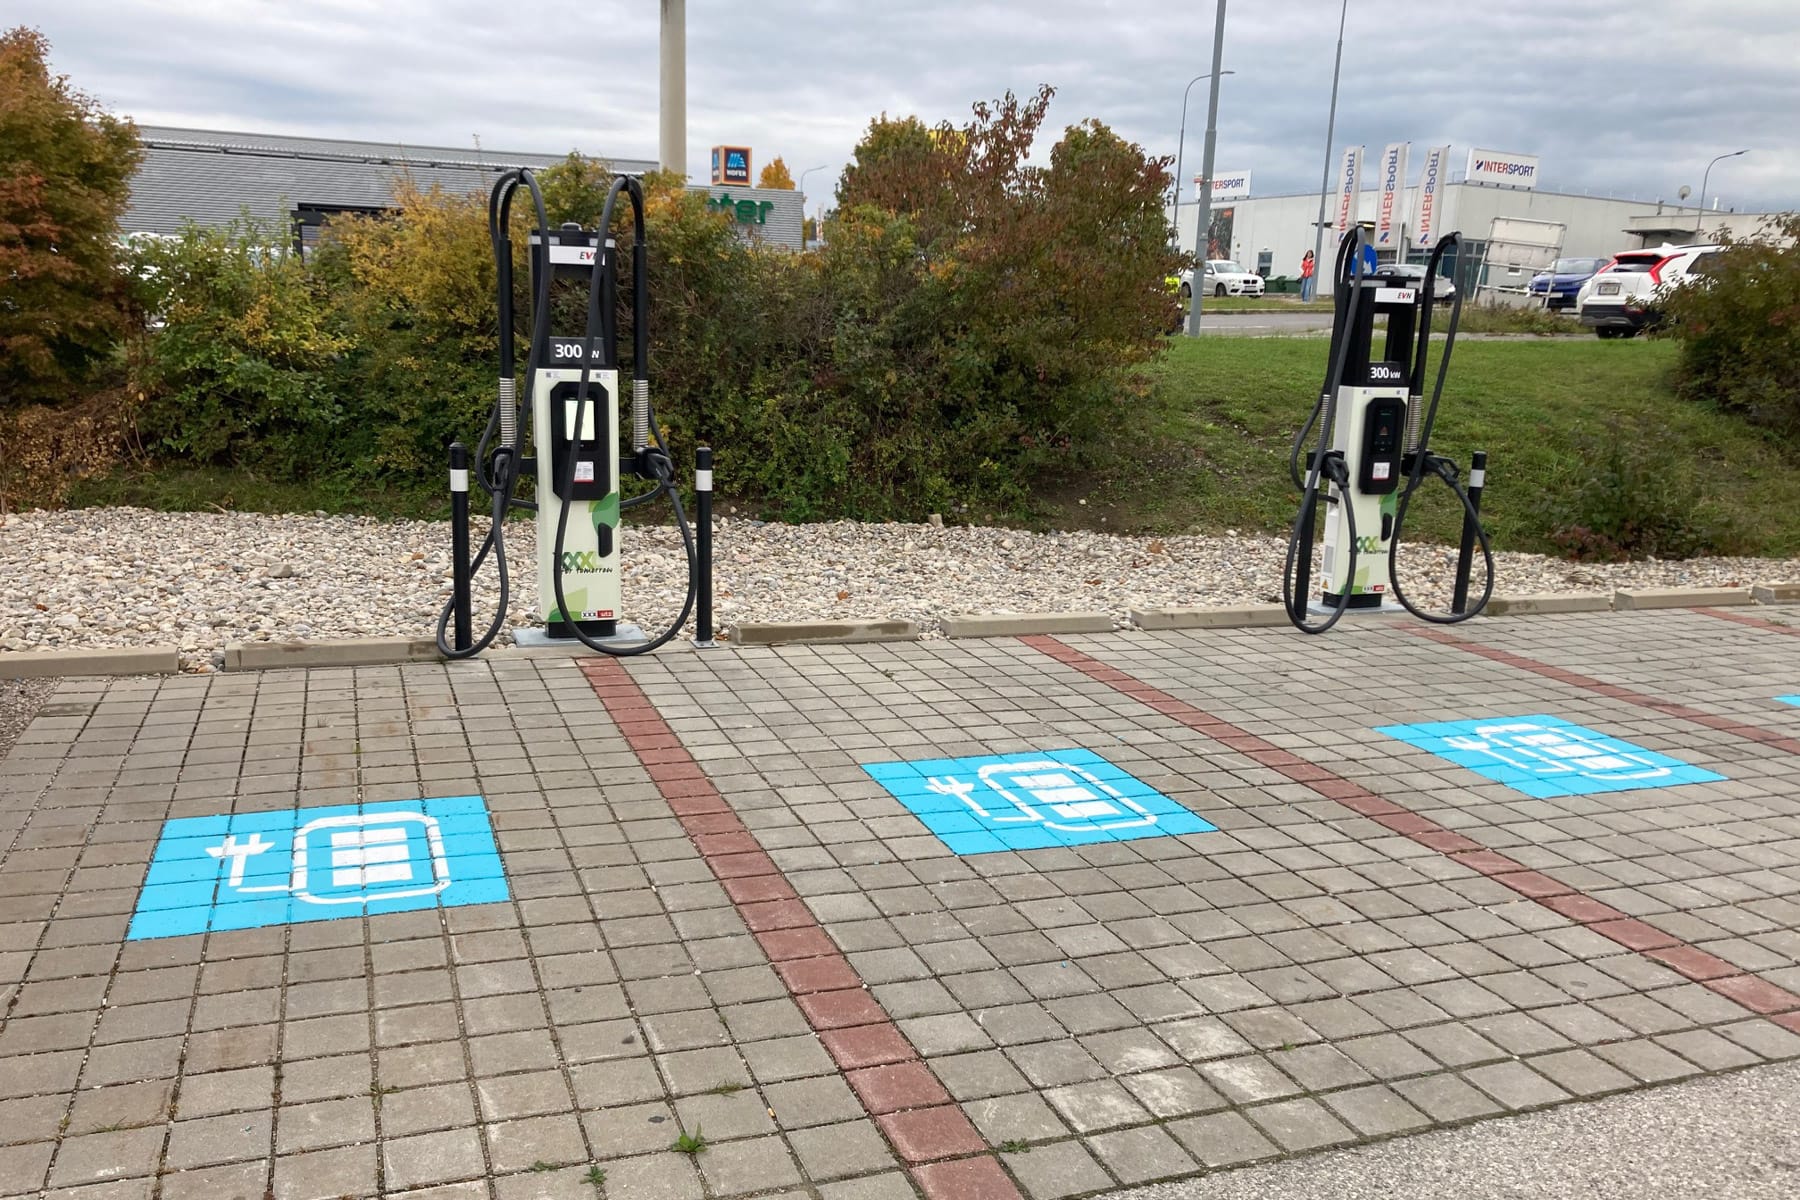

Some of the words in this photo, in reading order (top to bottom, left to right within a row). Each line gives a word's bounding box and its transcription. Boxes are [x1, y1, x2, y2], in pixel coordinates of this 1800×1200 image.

[726, 169, 747, 177] HOFER
[1483, 160, 1535, 177] INTERSPORT
[579, 251, 597, 260] EV
[1397, 291, 1412, 299] EVN
[554, 343, 583, 359] 300
[1370, 366, 1389, 379] 300
